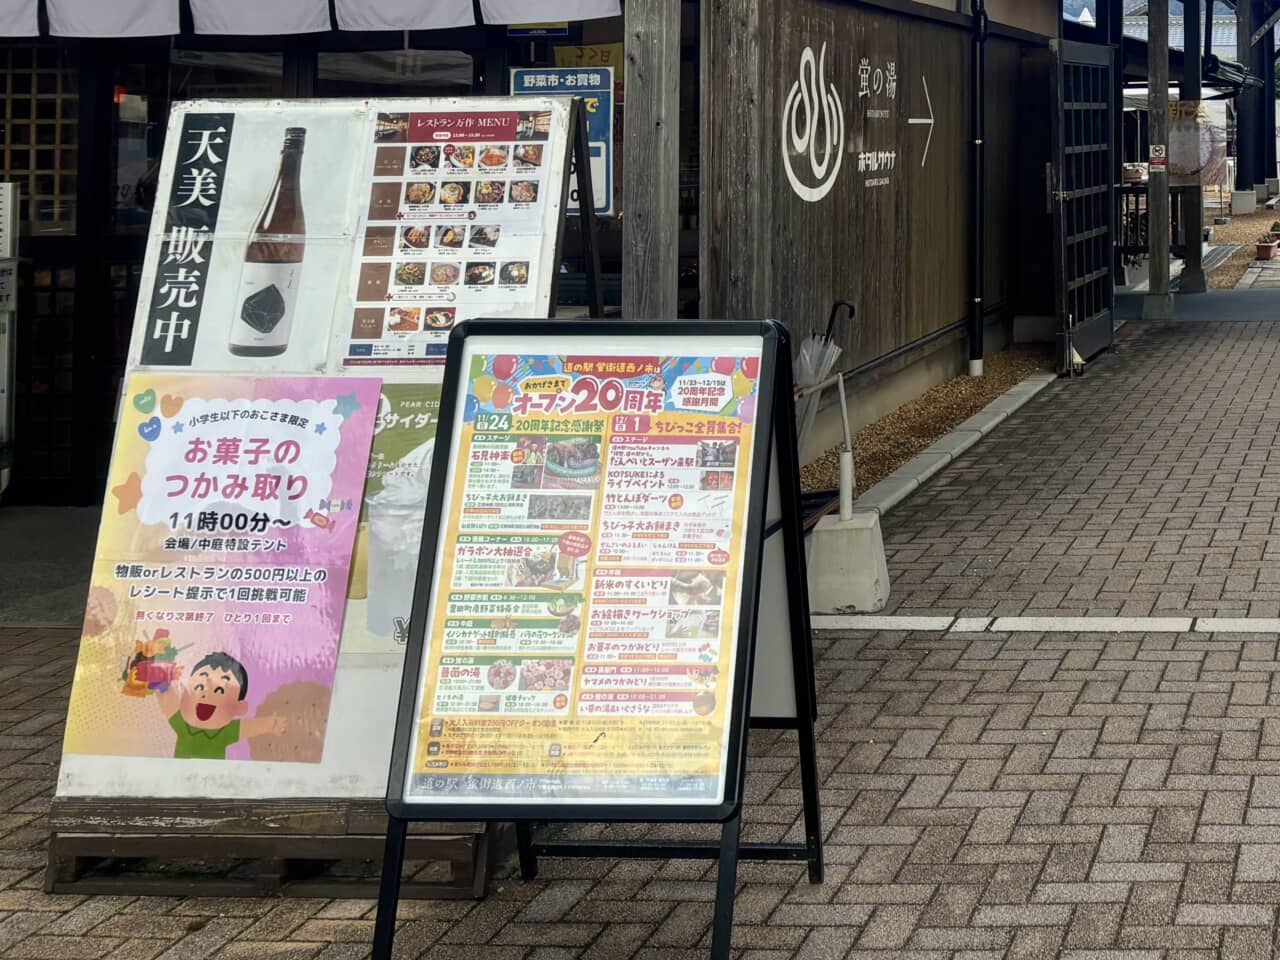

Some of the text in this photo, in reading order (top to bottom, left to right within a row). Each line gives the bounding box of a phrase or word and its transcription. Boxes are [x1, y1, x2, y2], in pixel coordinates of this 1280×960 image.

[523, 74, 601, 87] 野菜市・お買物
[858, 57, 897, 100] 蛍の湯
[417, 117, 511, 129] レストラン万作 MENU
[152, 126, 227, 353] 天美 販売中
[564, 362, 594, 373] 道の駅
[524, 380, 566, 389] おかげさまで
[512, 377, 664, 415] オープン20周年
[677, 387, 726, 396] 20周年記念
[682, 397, 719, 406] 感謝月間
[188, 409, 310, 430] 小学生以下のおこさま限定
[489, 414, 510, 430] 24
[516, 419, 604, 433] 20周年記念感謝祭
[184, 437, 301, 466] お菓子の
[165, 472, 308, 502] つかみ取り
[607, 480, 665, 489] ライブペイント
[606, 493, 668, 503] 竹とんぼダーツ
[602, 521, 680, 532] ちびっ子大お餅まき
[164, 537, 287, 552] 会場/中庭特設テント
[457, 545, 533, 557] ガラポン大抽選会
[115, 564, 327, 583] 物販orレストランの500円以上の
[594, 579, 668, 590] 新米のすくいどり
[129, 585, 308, 603] レシート提示で1回挑戦可能
[135, 611, 215, 623] 無くなり次第終了
